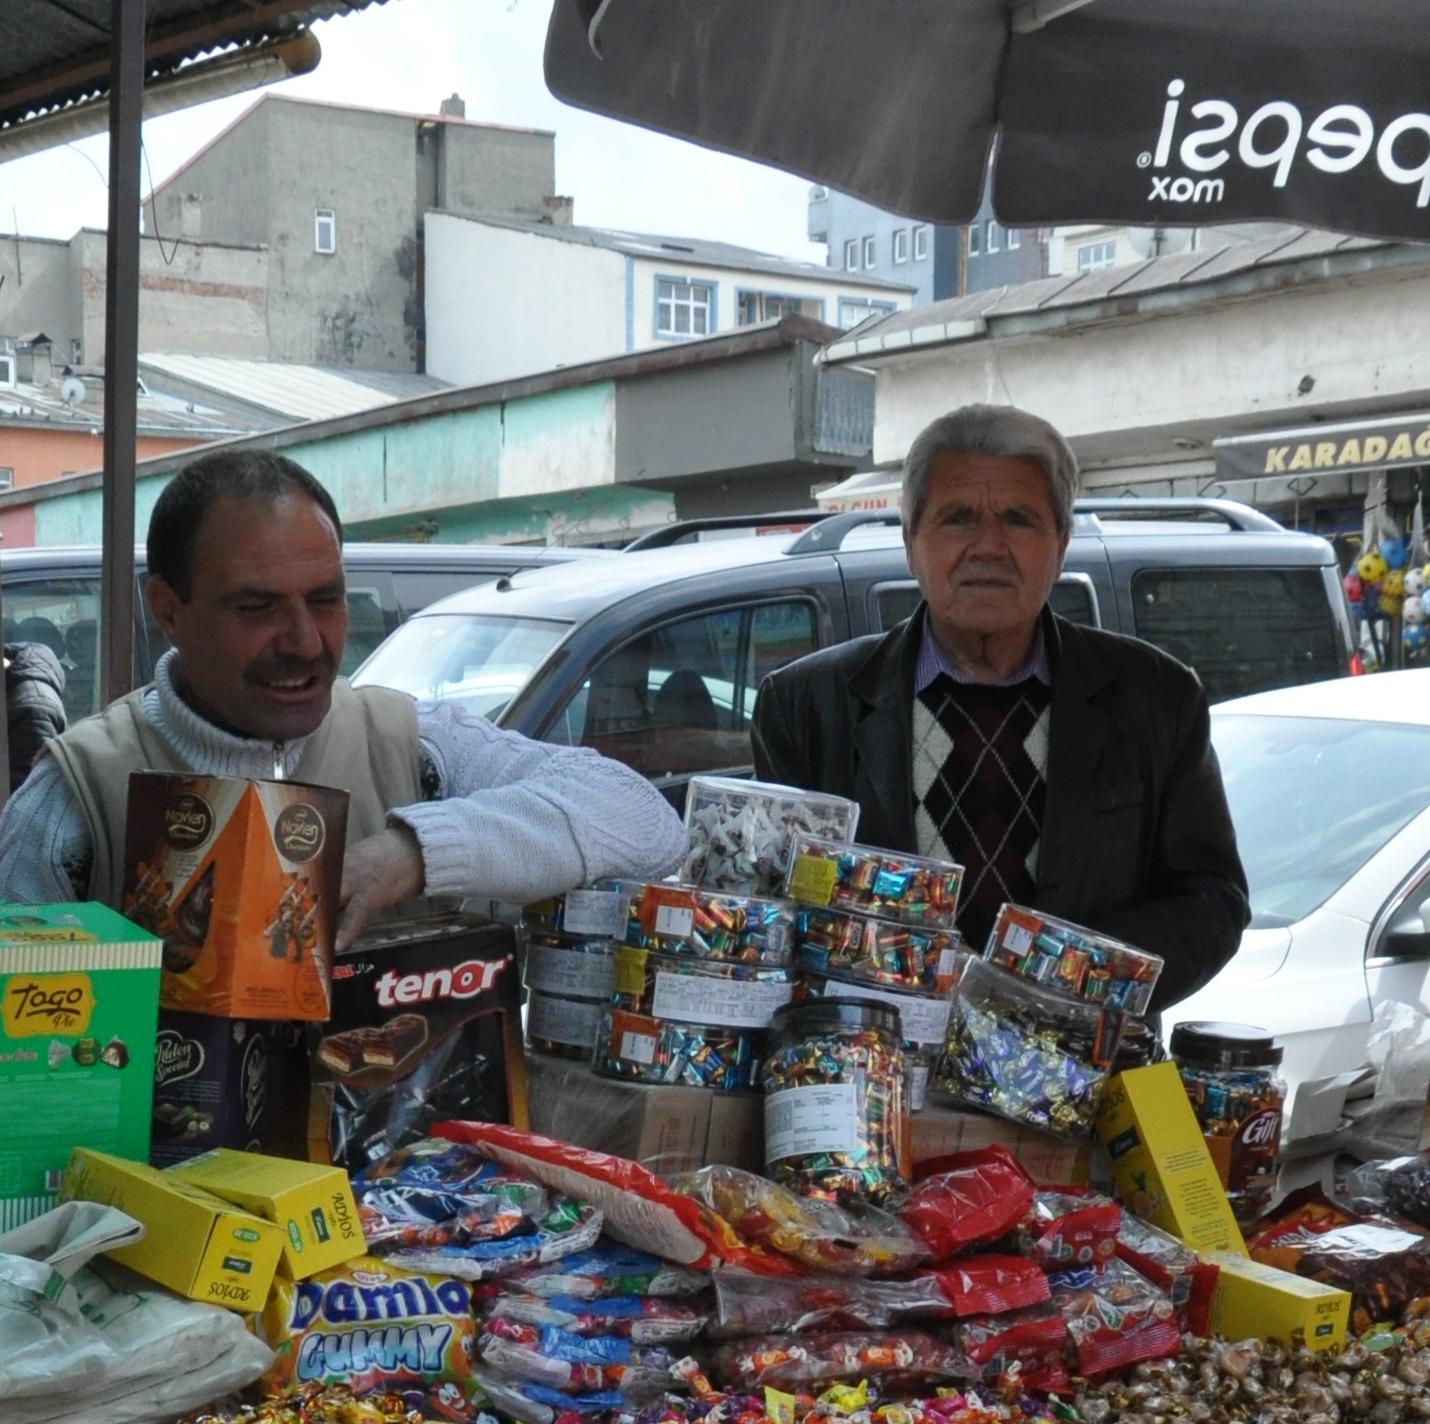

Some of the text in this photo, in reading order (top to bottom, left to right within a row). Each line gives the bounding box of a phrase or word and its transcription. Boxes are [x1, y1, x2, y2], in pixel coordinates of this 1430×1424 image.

[11, 982, 84, 1019] Togo
[375, 958, 508, 1008] tenor
[297, 1323, 453, 1382] GUMMY
